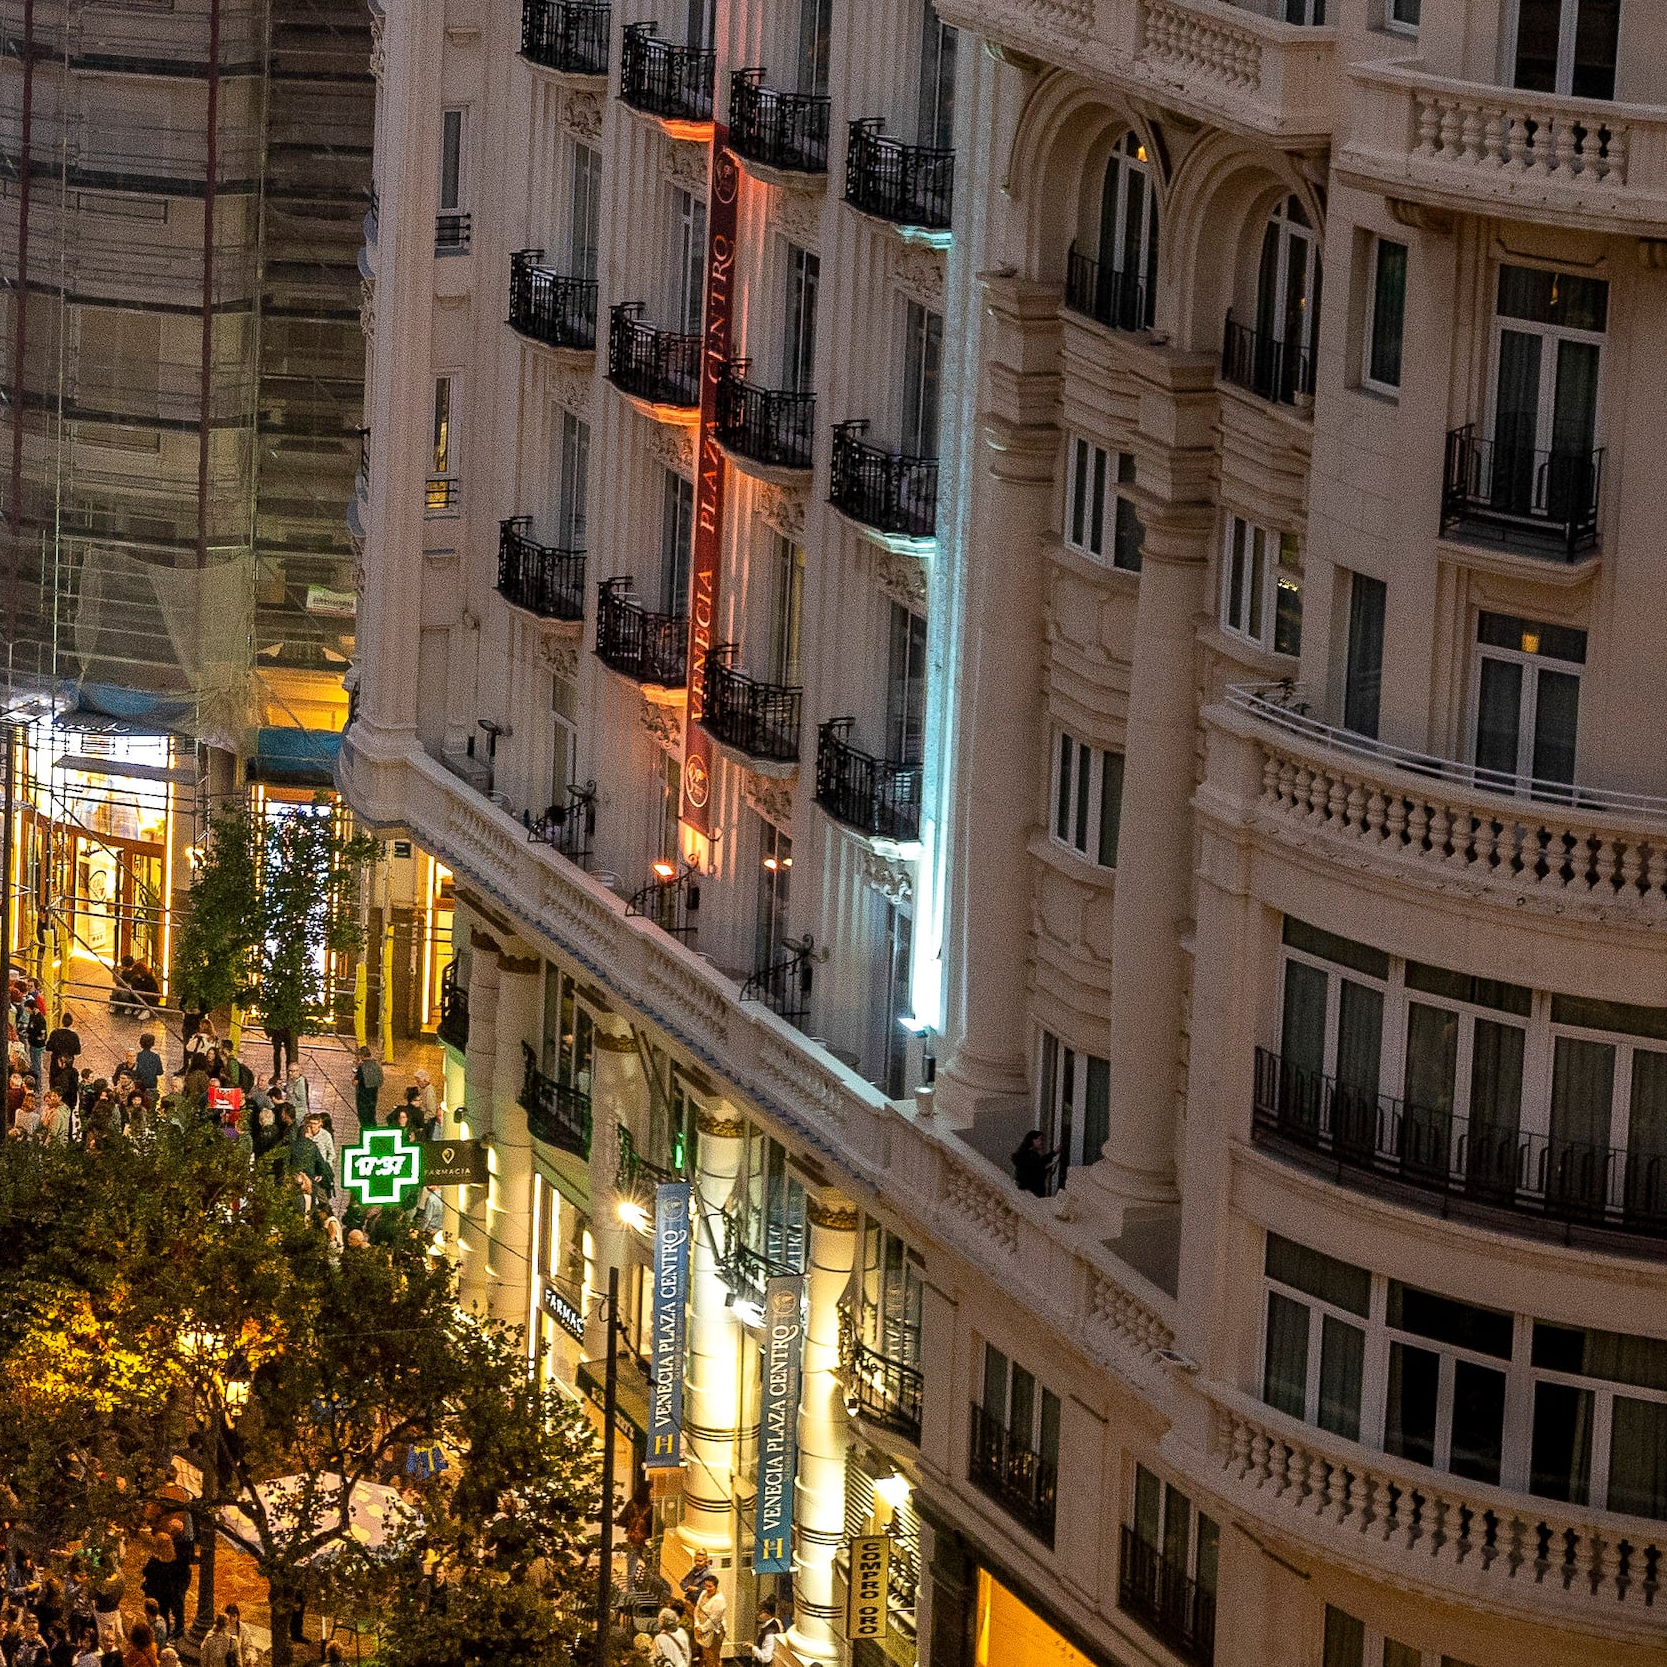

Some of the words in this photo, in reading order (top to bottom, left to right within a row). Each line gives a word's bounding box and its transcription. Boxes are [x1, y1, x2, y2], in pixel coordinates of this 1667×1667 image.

[699, 421, 720, 534] PLAZA
[691, 569, 713, 721] VENECIA
[354, 1155, 406, 1177] 17:37
[660, 1229, 687, 1299] CENTRO
[658, 1301, 676, 1354] PLAZA
[770, 1325, 798, 1397] CENTRO
[655, 1355, 673, 1428] VENECIA
[767, 1400, 786, 1452] PLAZA
[763, 1456, 784, 1531] VENECIA
[859, 1542, 881, 1599] COMPRO
[858, 1606, 879, 1634] ORO
